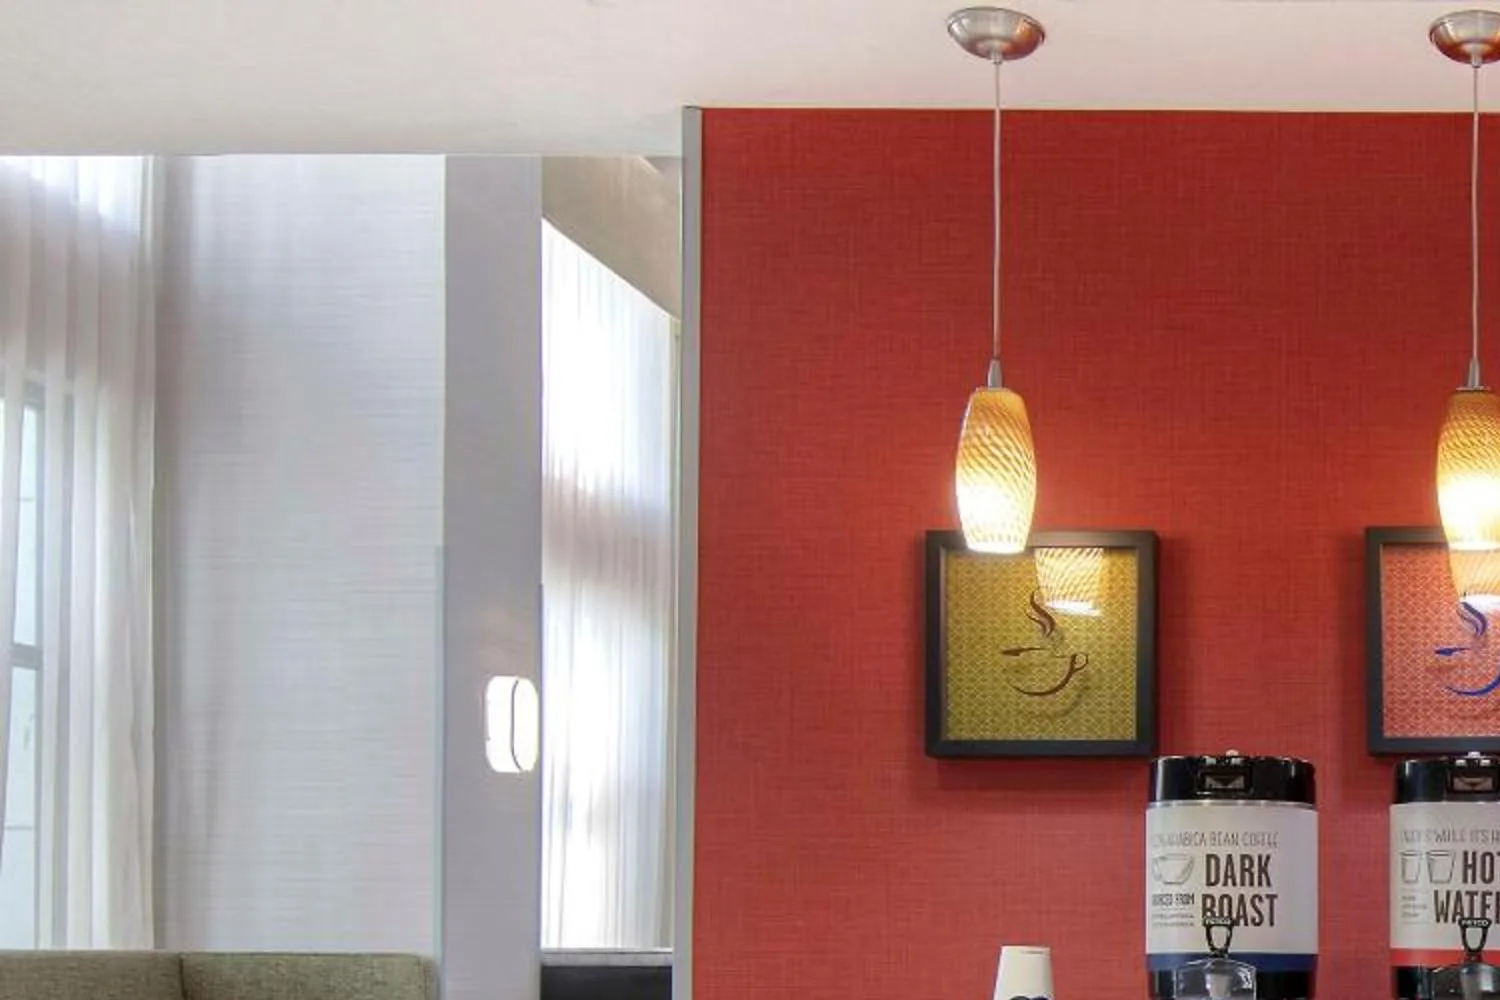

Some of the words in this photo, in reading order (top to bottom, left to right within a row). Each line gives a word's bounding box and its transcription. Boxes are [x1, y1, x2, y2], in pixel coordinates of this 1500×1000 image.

[1209, 831, 1239, 847] BEAN
[1205, 853, 1272, 887] DARK
[1201, 893, 1279, 927] ROAST
